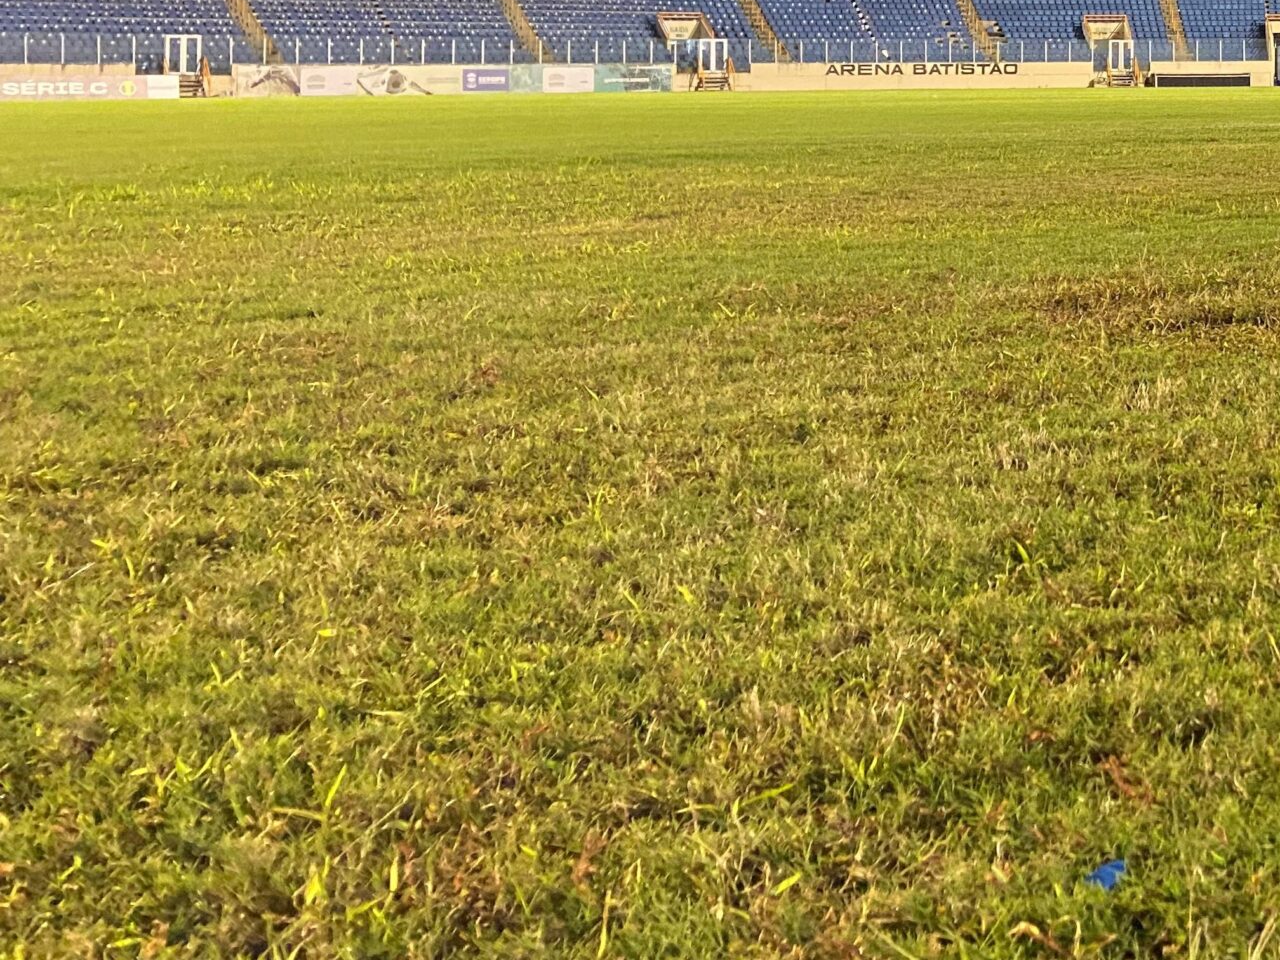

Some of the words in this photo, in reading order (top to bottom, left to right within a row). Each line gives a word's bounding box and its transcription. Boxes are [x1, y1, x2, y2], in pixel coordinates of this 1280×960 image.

[825, 63, 904, 76] ARENA
[2, 78, 84, 96] SÉRIE
[89, 81, 108, 95] C
